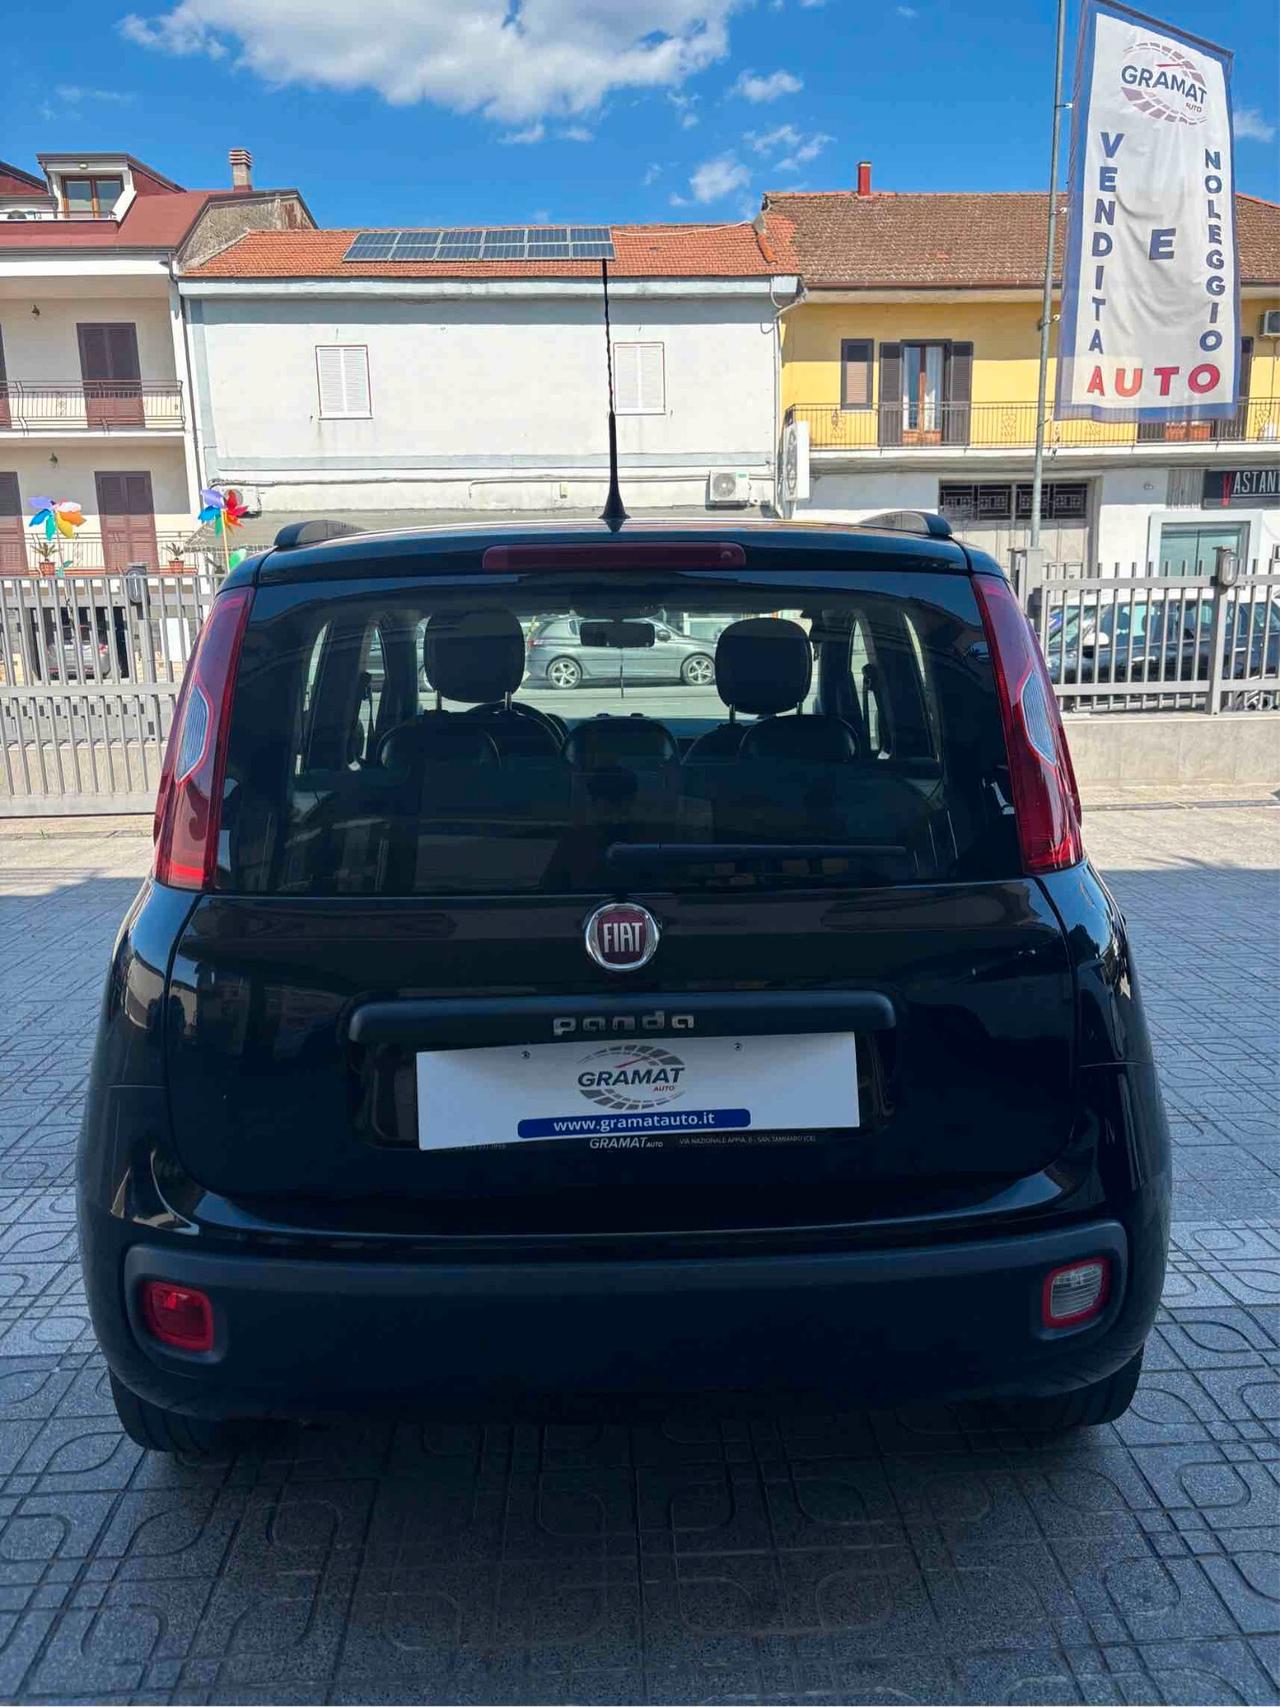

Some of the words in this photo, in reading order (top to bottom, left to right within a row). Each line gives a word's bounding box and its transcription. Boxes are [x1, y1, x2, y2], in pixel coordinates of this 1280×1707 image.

[1121, 65, 1207, 104] GRAMAT
[1185, 102, 1202, 113] AUTO
[1088, 131, 1125, 355] VENDITA
[1149, 228, 1177, 261] E
[1199, 148, 1226, 353] NOLEGGIO
[1087, 363, 1221, 397] AUTO
[603, 922, 643, 953] FIAT
[553, 1010, 695, 1036] panda
[577, 1068, 686, 1088] GRAMAT
[553, 1112, 715, 1132] www.gramatauto.it
[589, 1136, 647, 1150] GRAMAT
